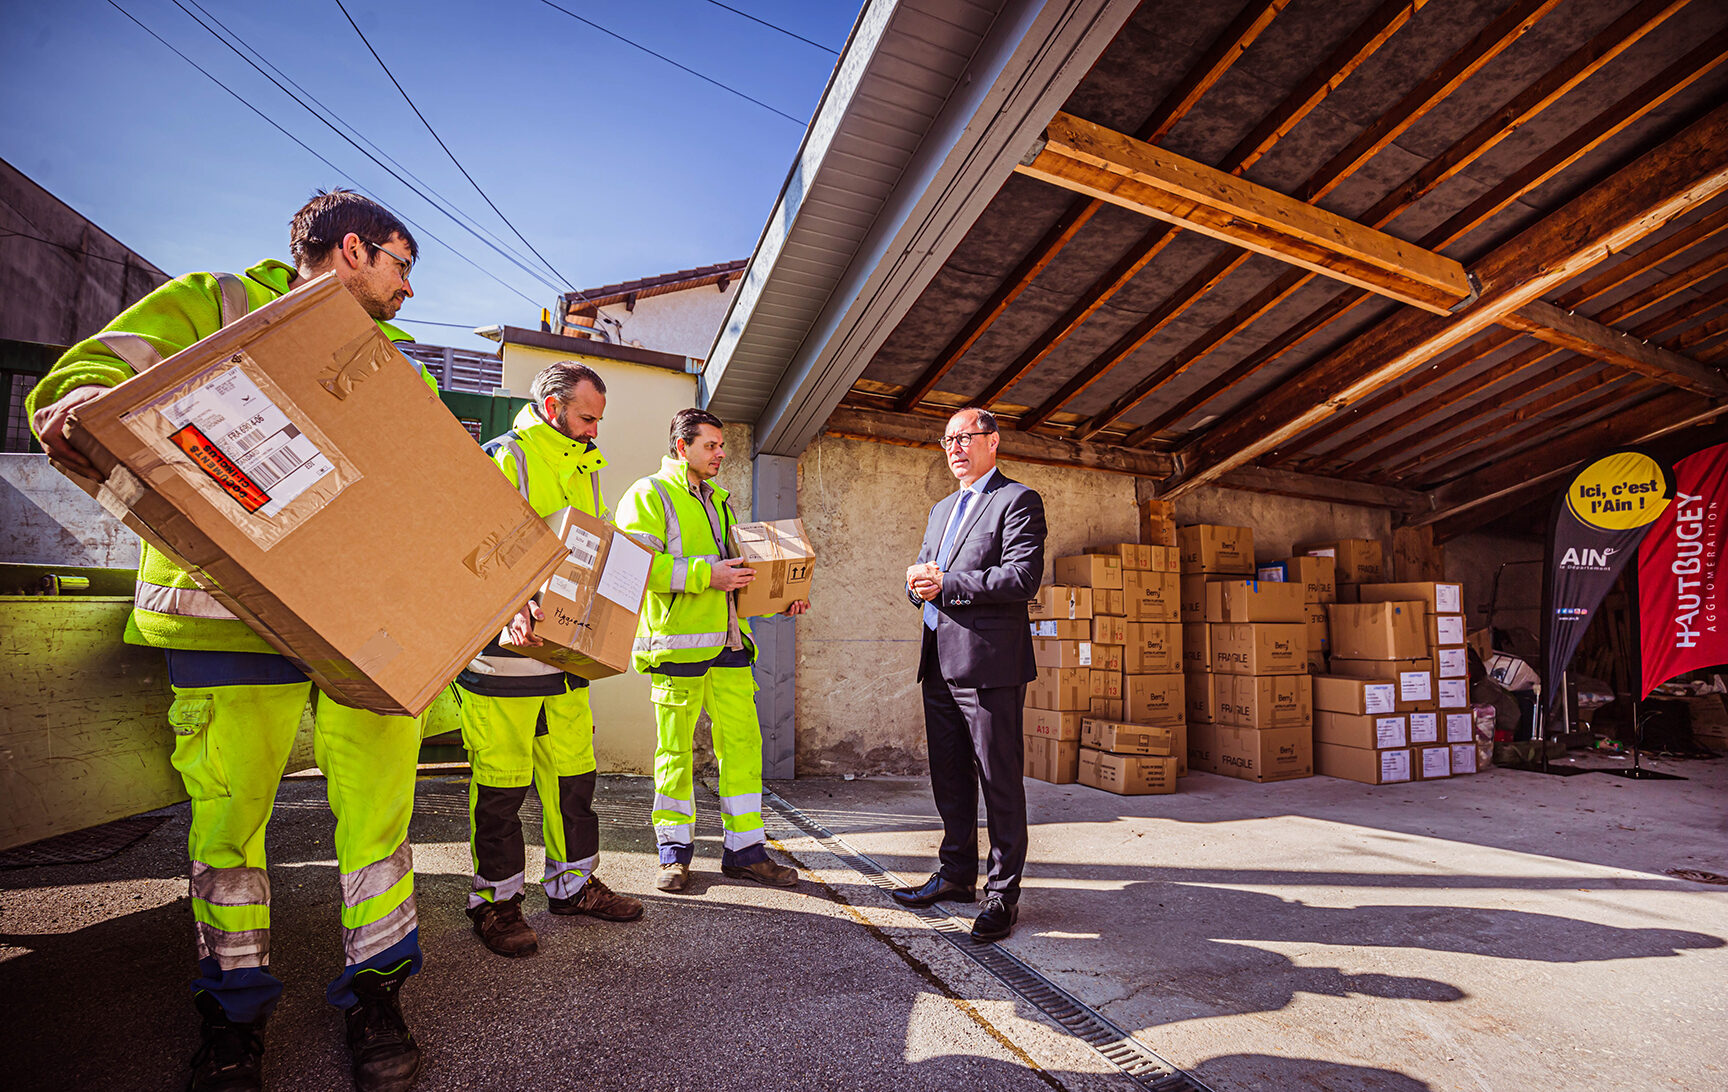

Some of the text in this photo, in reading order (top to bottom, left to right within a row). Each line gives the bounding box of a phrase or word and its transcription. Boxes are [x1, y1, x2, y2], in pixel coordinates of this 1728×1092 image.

[228, 430, 242, 440] FRA
[237, 450, 260, 466] TANDARD
[190, 445, 247, 498] DOCUMENTS
[1580, 480, 1658, 499] Ici, c'est
[1591, 497, 1645, 513] l'Ain !
[1672, 492, 1703, 647] HAUTBUGEY
[1036, 725, 1050, 735] A13
[1222, 755, 1253, 770] FRAGILE
